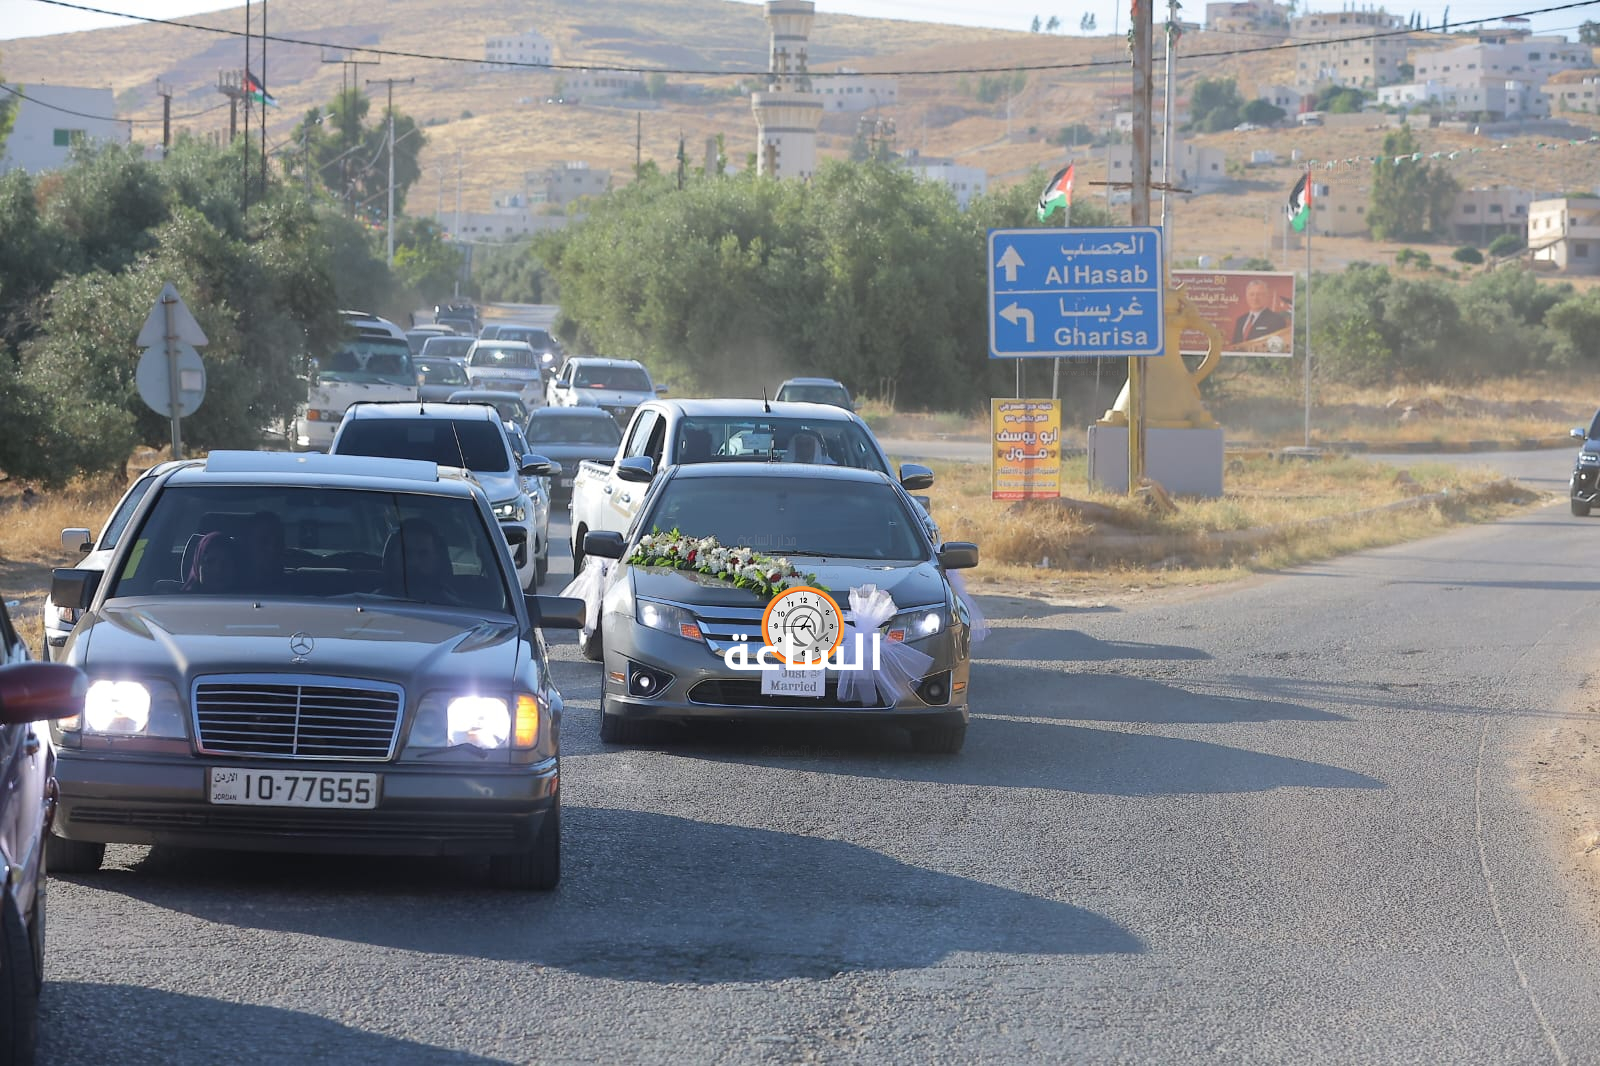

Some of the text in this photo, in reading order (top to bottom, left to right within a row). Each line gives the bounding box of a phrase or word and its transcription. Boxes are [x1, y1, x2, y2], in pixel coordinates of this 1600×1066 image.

[1045, 265, 1148, 285] Al Hasab
[1059, 296, 1144, 323] غريسا
[1054, 327, 1148, 346] Gharisa
[996, 429, 1037, 445] يوسف
[1006, 446, 1048, 461] مول
[782, 667, 807, 679] Just
[771, 680, 817, 692] Married
[214, 793, 237, 801] JORDAN
[245, 774, 370, 804] 10-77655
